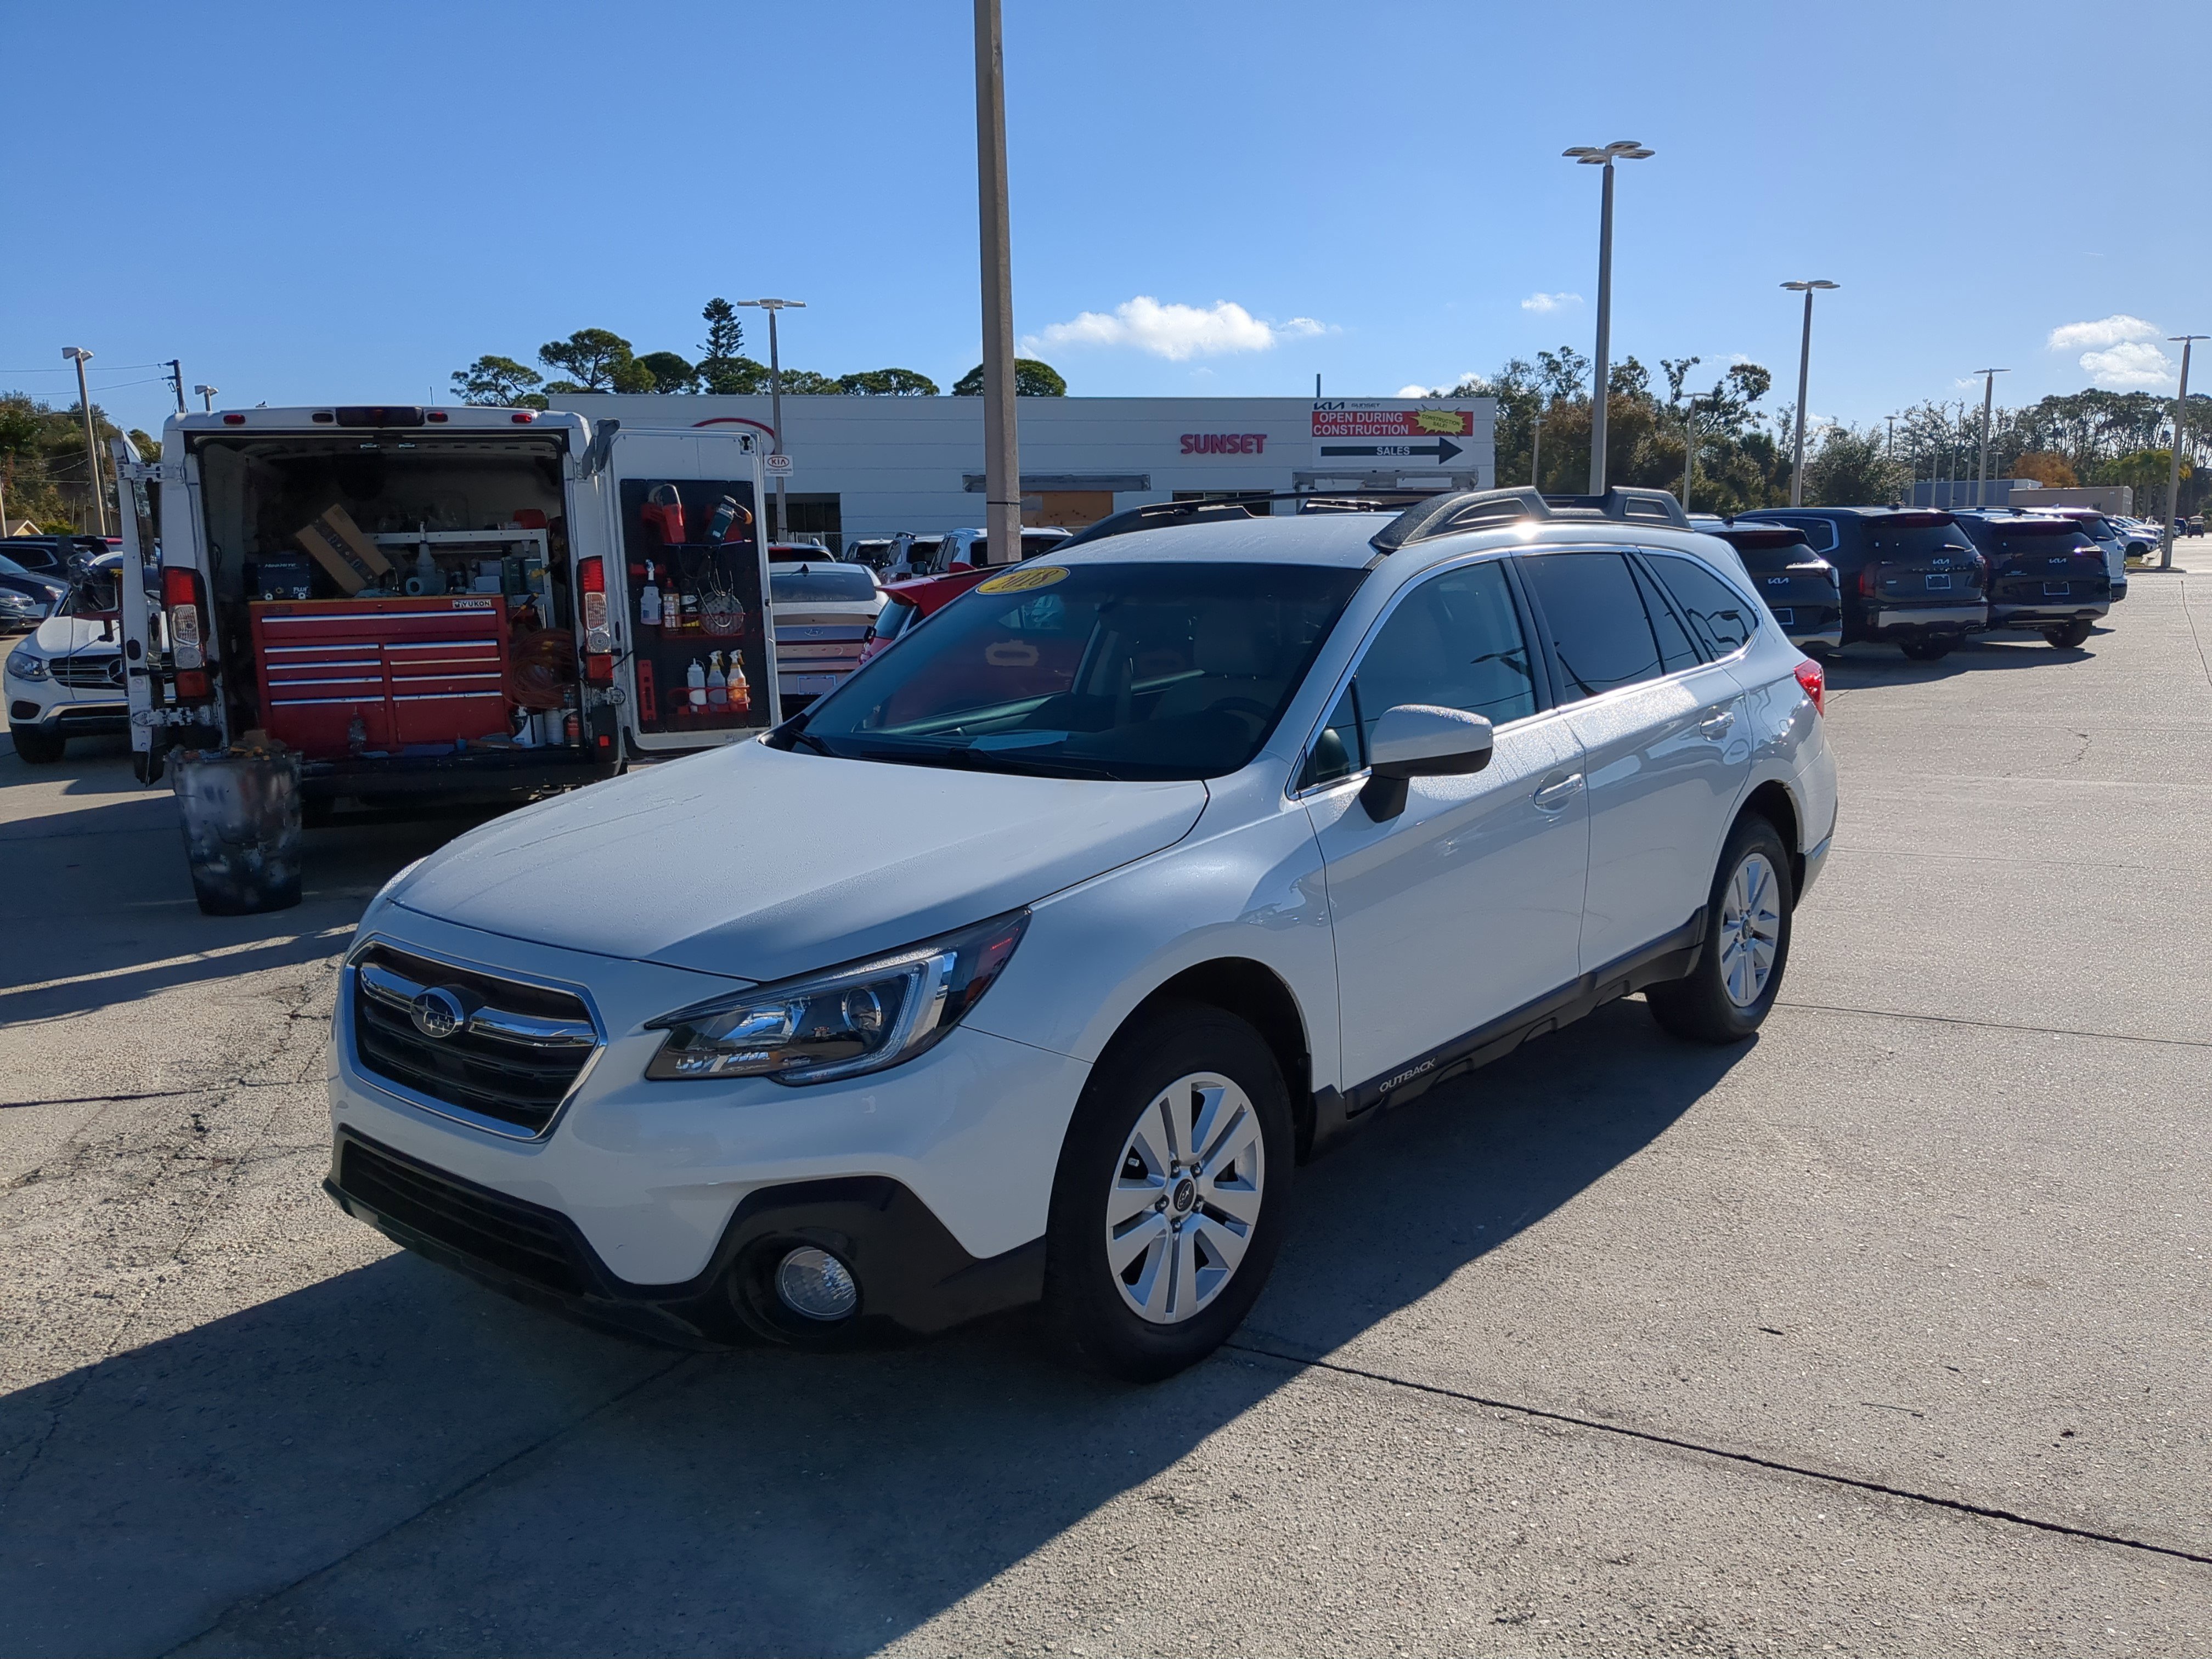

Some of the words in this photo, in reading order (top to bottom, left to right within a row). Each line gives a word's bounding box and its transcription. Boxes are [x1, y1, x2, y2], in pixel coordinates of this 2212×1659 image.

[1319, 413, 1353, 422] OPEN
[1357, 413, 1403, 422] DURING
[1422, 414, 1460, 426] CONSTRUCTION
[1313, 424, 1409, 435] CONSTRUCTION
[1181, 434, 1267, 454] SUNSET
[1376, 447, 1410, 455] SALES
[1379, 1058, 1436, 1093] OUTBACK
